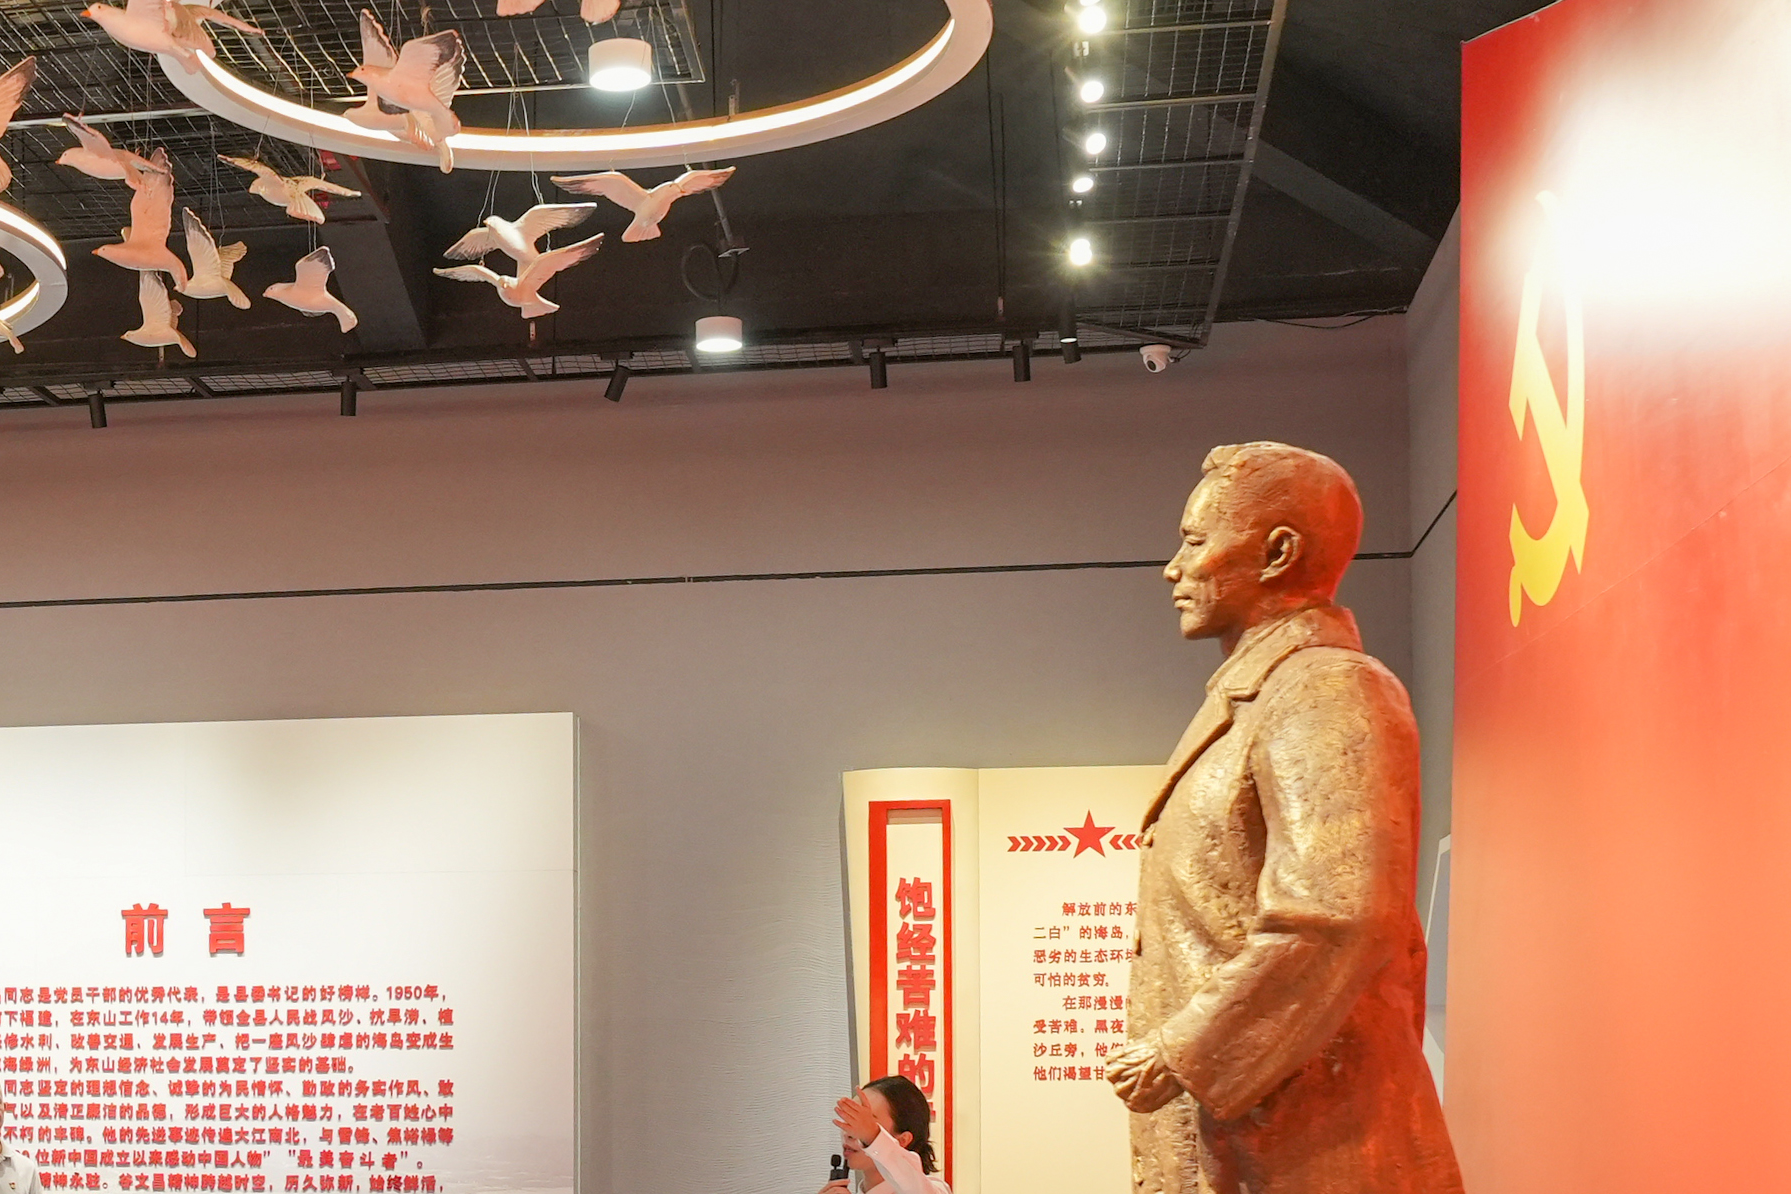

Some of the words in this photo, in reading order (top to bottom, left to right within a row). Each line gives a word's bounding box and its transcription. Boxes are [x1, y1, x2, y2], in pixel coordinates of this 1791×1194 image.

[1062, 901, 1138, 917] 解放前的东
[121, 902, 251, 955] 前言
[1033, 972, 1110, 988] 可怕的贫穷。
[895, 877, 937, 1122] 饱经苦难的
[1033, 1019, 1127, 1034] 受苦难。黑夜
[1033, 1066, 1105, 1081] 他们渴望甘
